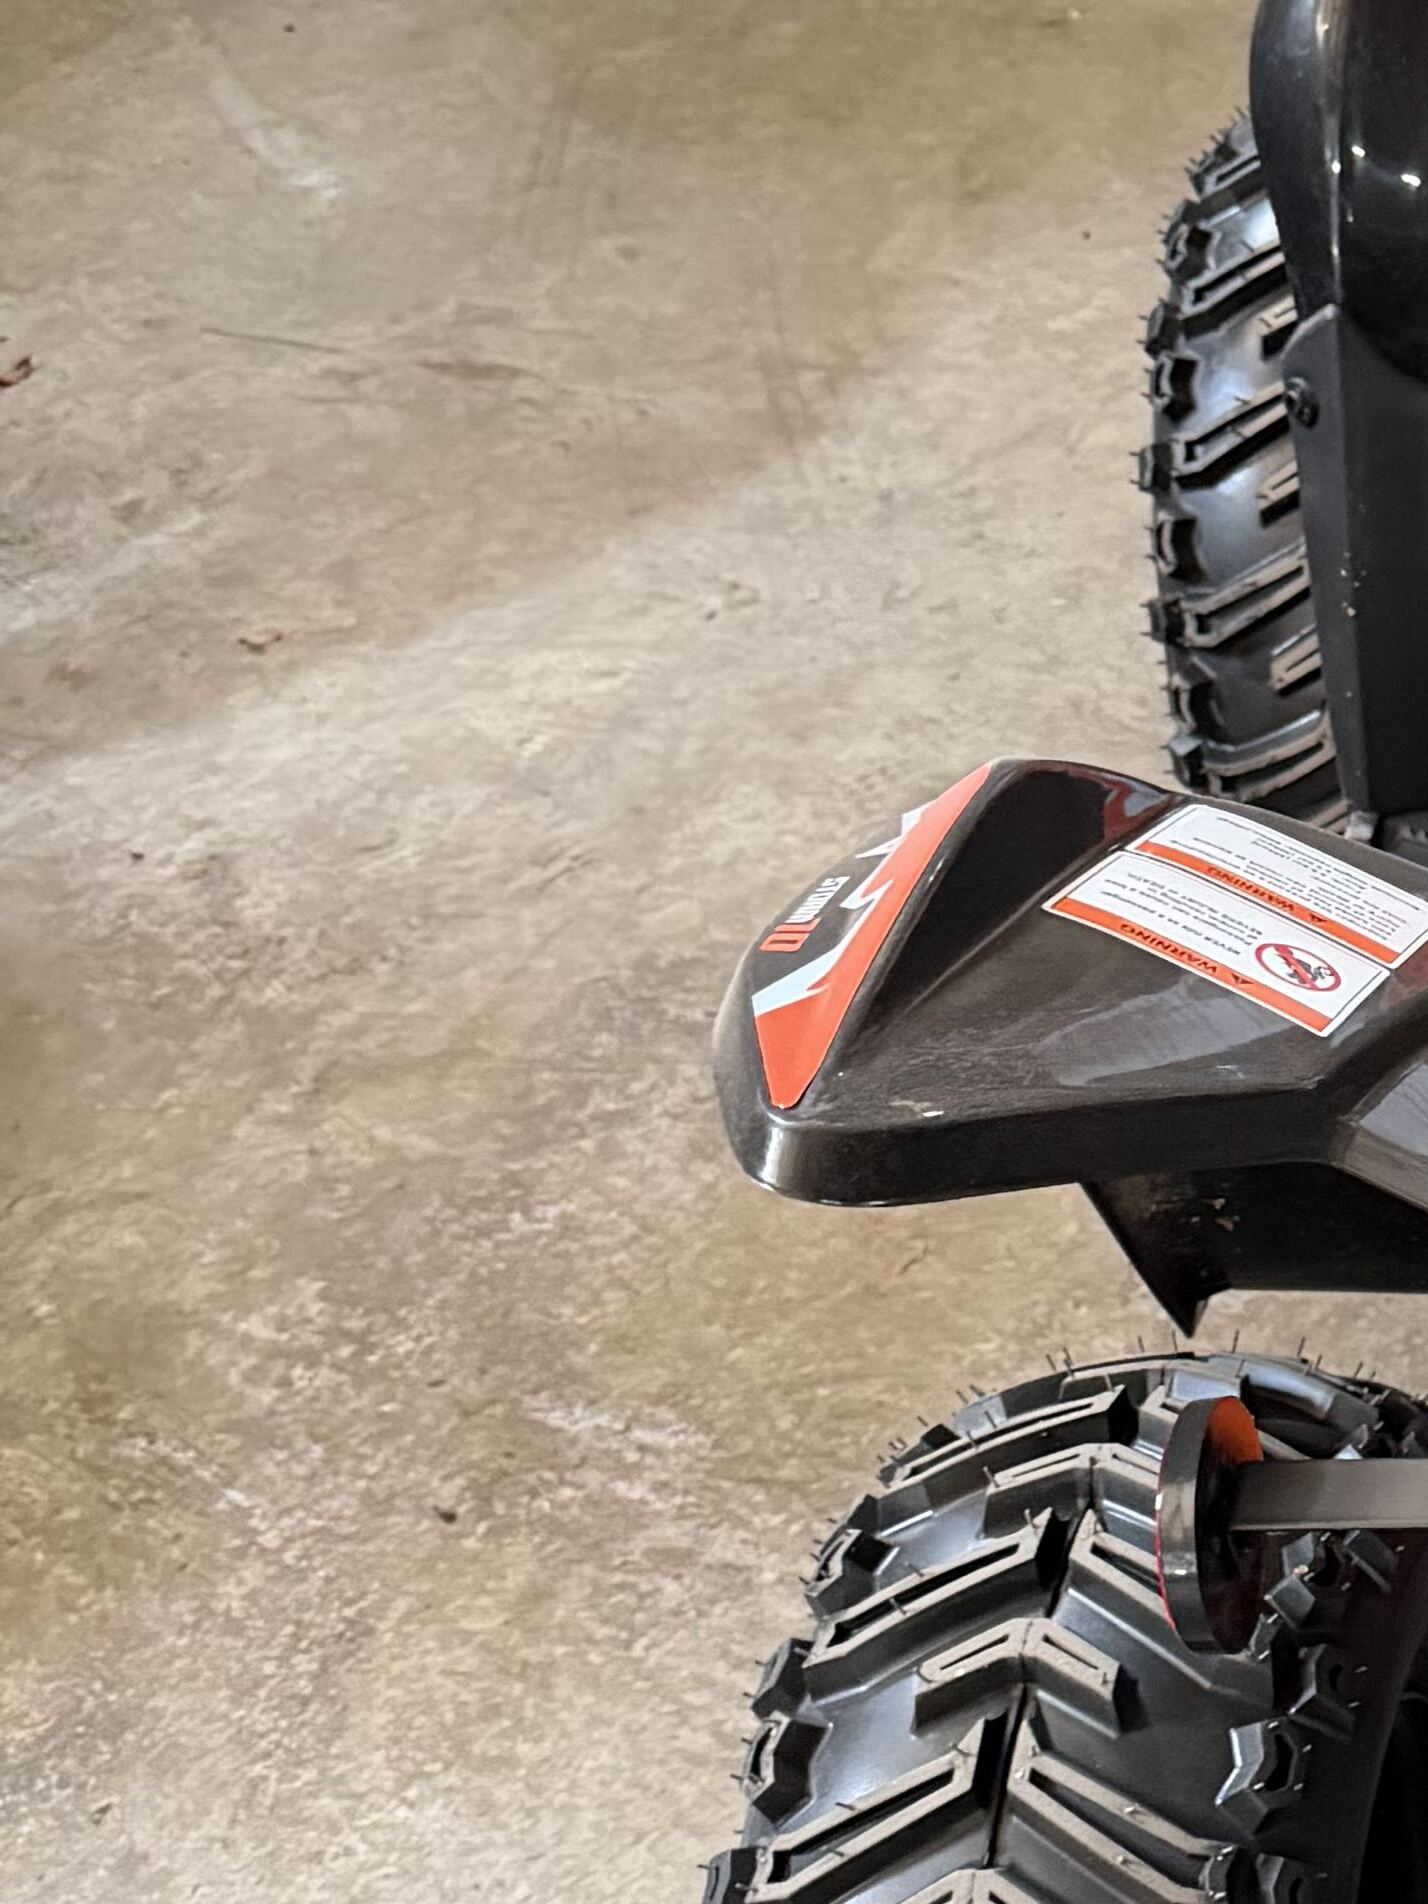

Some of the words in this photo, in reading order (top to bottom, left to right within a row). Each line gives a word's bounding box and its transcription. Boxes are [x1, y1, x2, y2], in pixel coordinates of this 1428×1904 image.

[1202, 866, 1298, 911] WARNING
[758, 916, 822, 953] 70
[1116, 922, 1221, 973] WARNING
